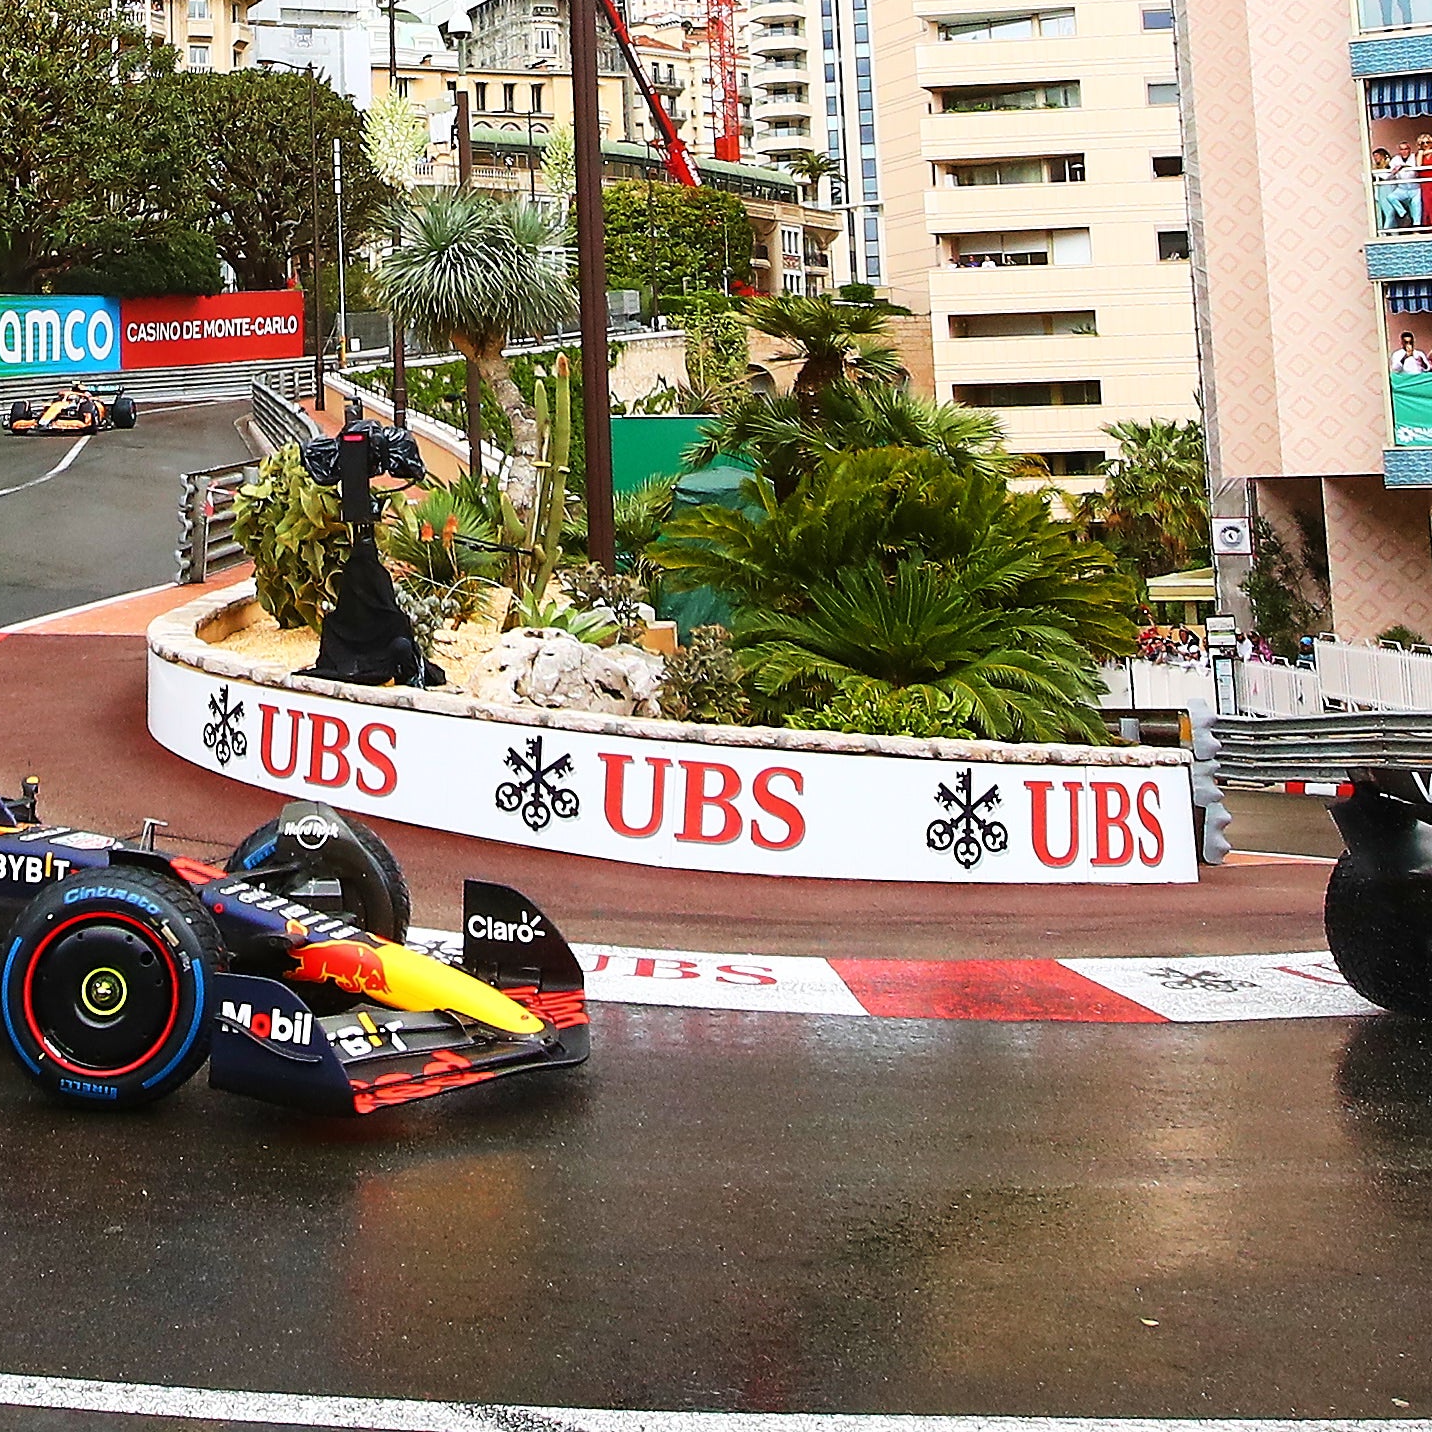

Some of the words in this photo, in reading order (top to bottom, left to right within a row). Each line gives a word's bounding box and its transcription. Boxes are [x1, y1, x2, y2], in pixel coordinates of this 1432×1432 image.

[126, 321, 180, 343] CASINO
[182, 321, 202, 340] DE
[205, 315, 298, 338] MONTE-CARLO
[258, 703, 399, 798] UBS
[598, 753, 807, 851] UBS
[284, 821, 313, 837] Hard
[1024, 780, 1163, 868] UBS
[62, 885, 162, 916] Cinturato
[467, 913, 536, 944] Claro
[221, 1000, 313, 1046] Mobil
